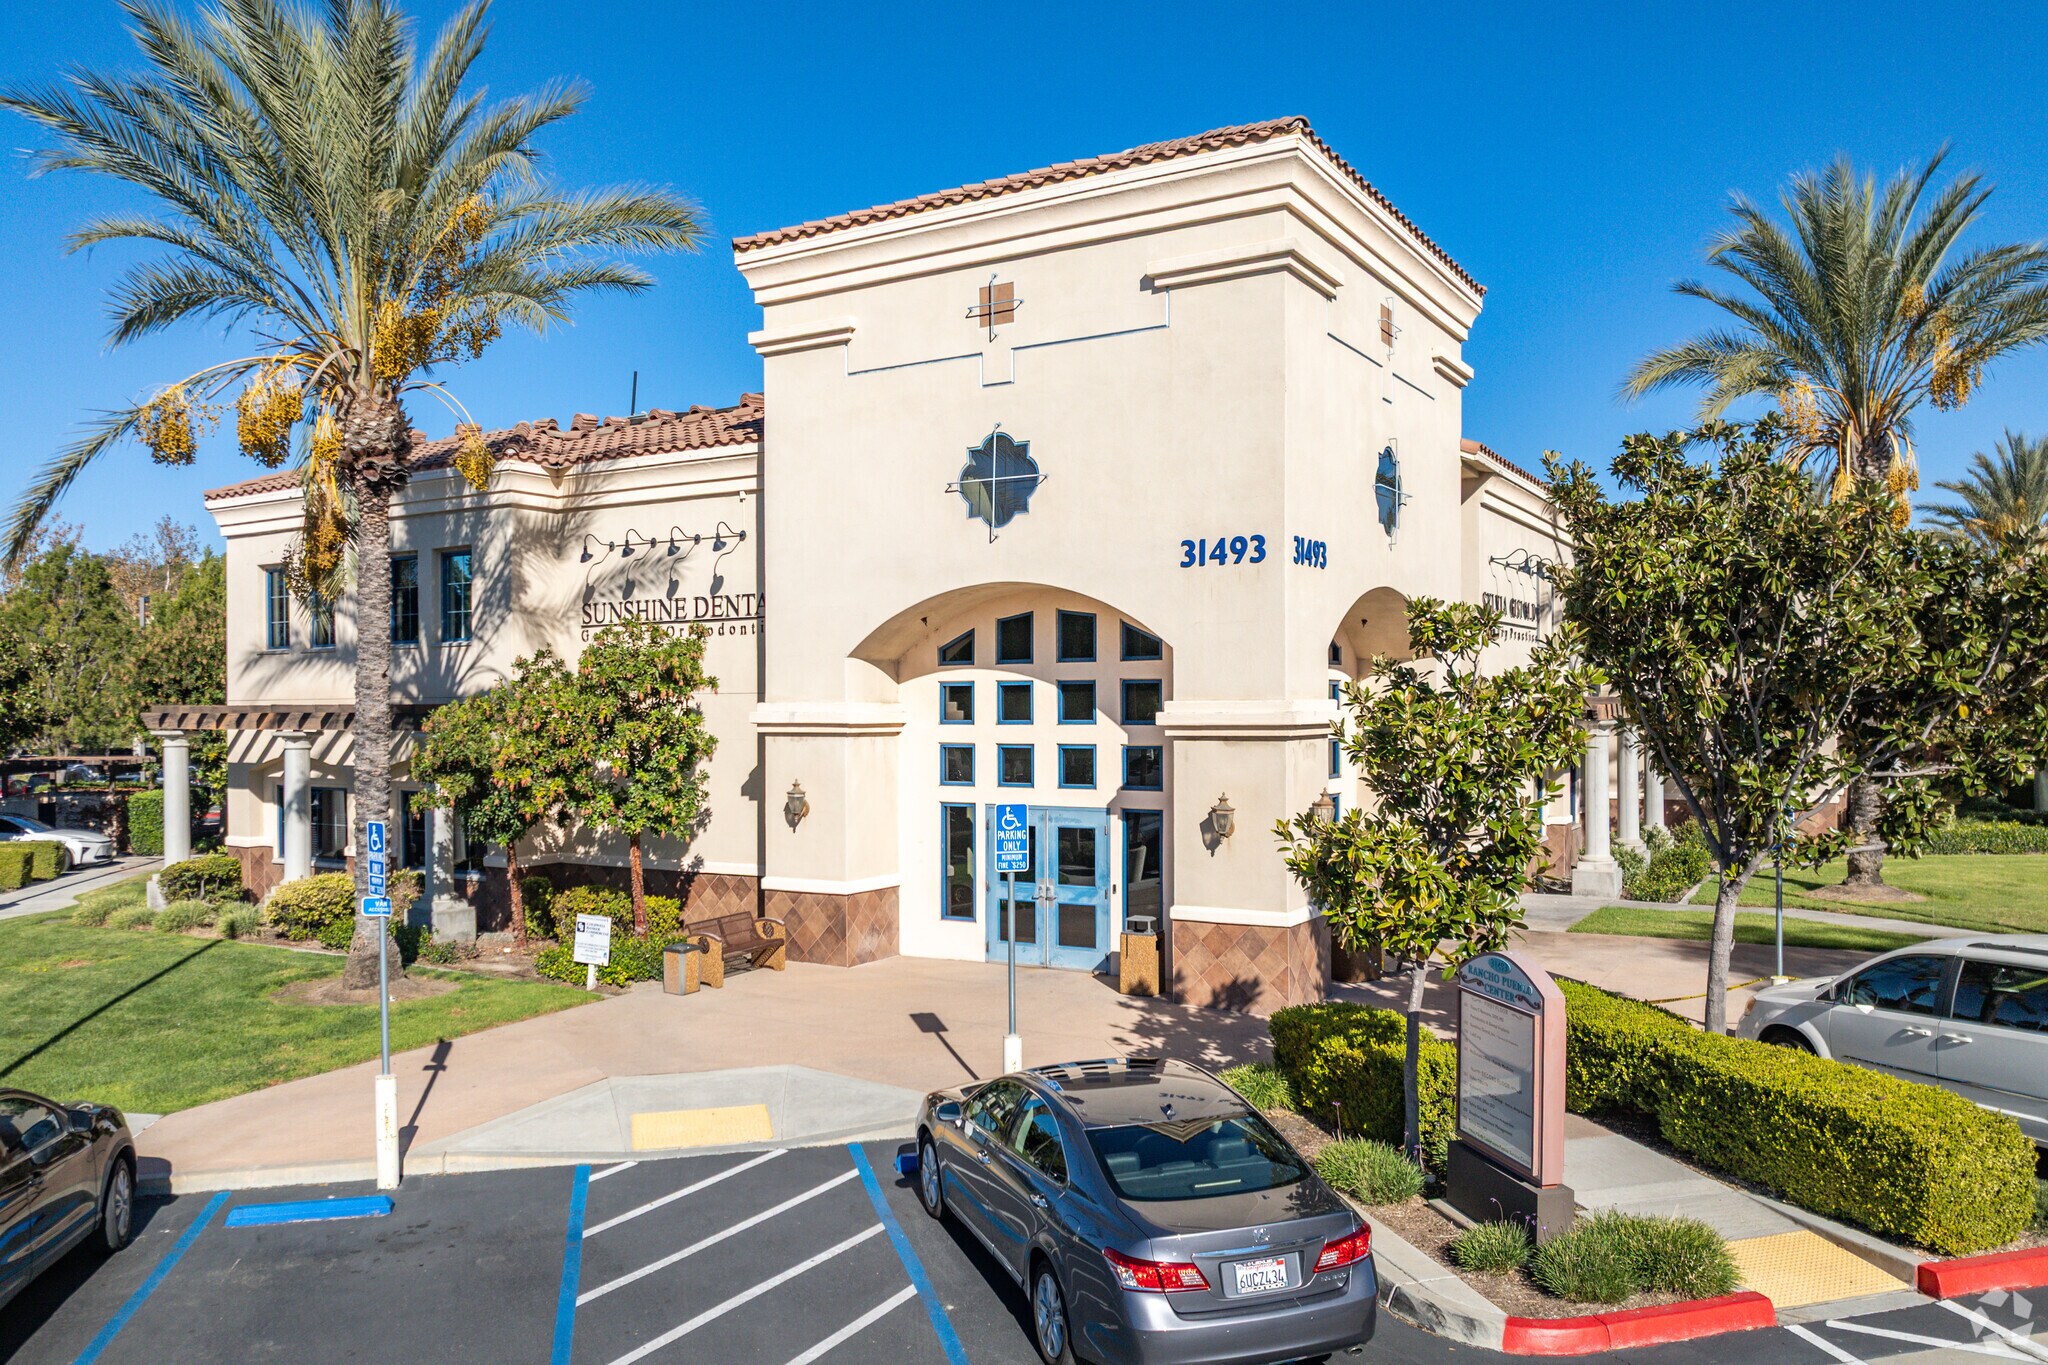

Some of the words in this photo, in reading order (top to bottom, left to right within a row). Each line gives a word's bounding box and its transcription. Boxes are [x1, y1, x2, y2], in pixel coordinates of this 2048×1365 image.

[1180, 534, 1266, 568] 31493
[1293, 536, 1327, 569] 31493
[581, 598, 688, 624] SUNSHINE
[998, 830, 1026, 840] PARKING
[1003, 841, 1020, 851] ONLY
[1468, 965, 1500, 984] RANCHO
[1502, 976, 1534, 996] PUEBLO
[1484, 983, 1516, 1002] CENTER
[1240, 1268, 1284, 1288] 6UCZ434
